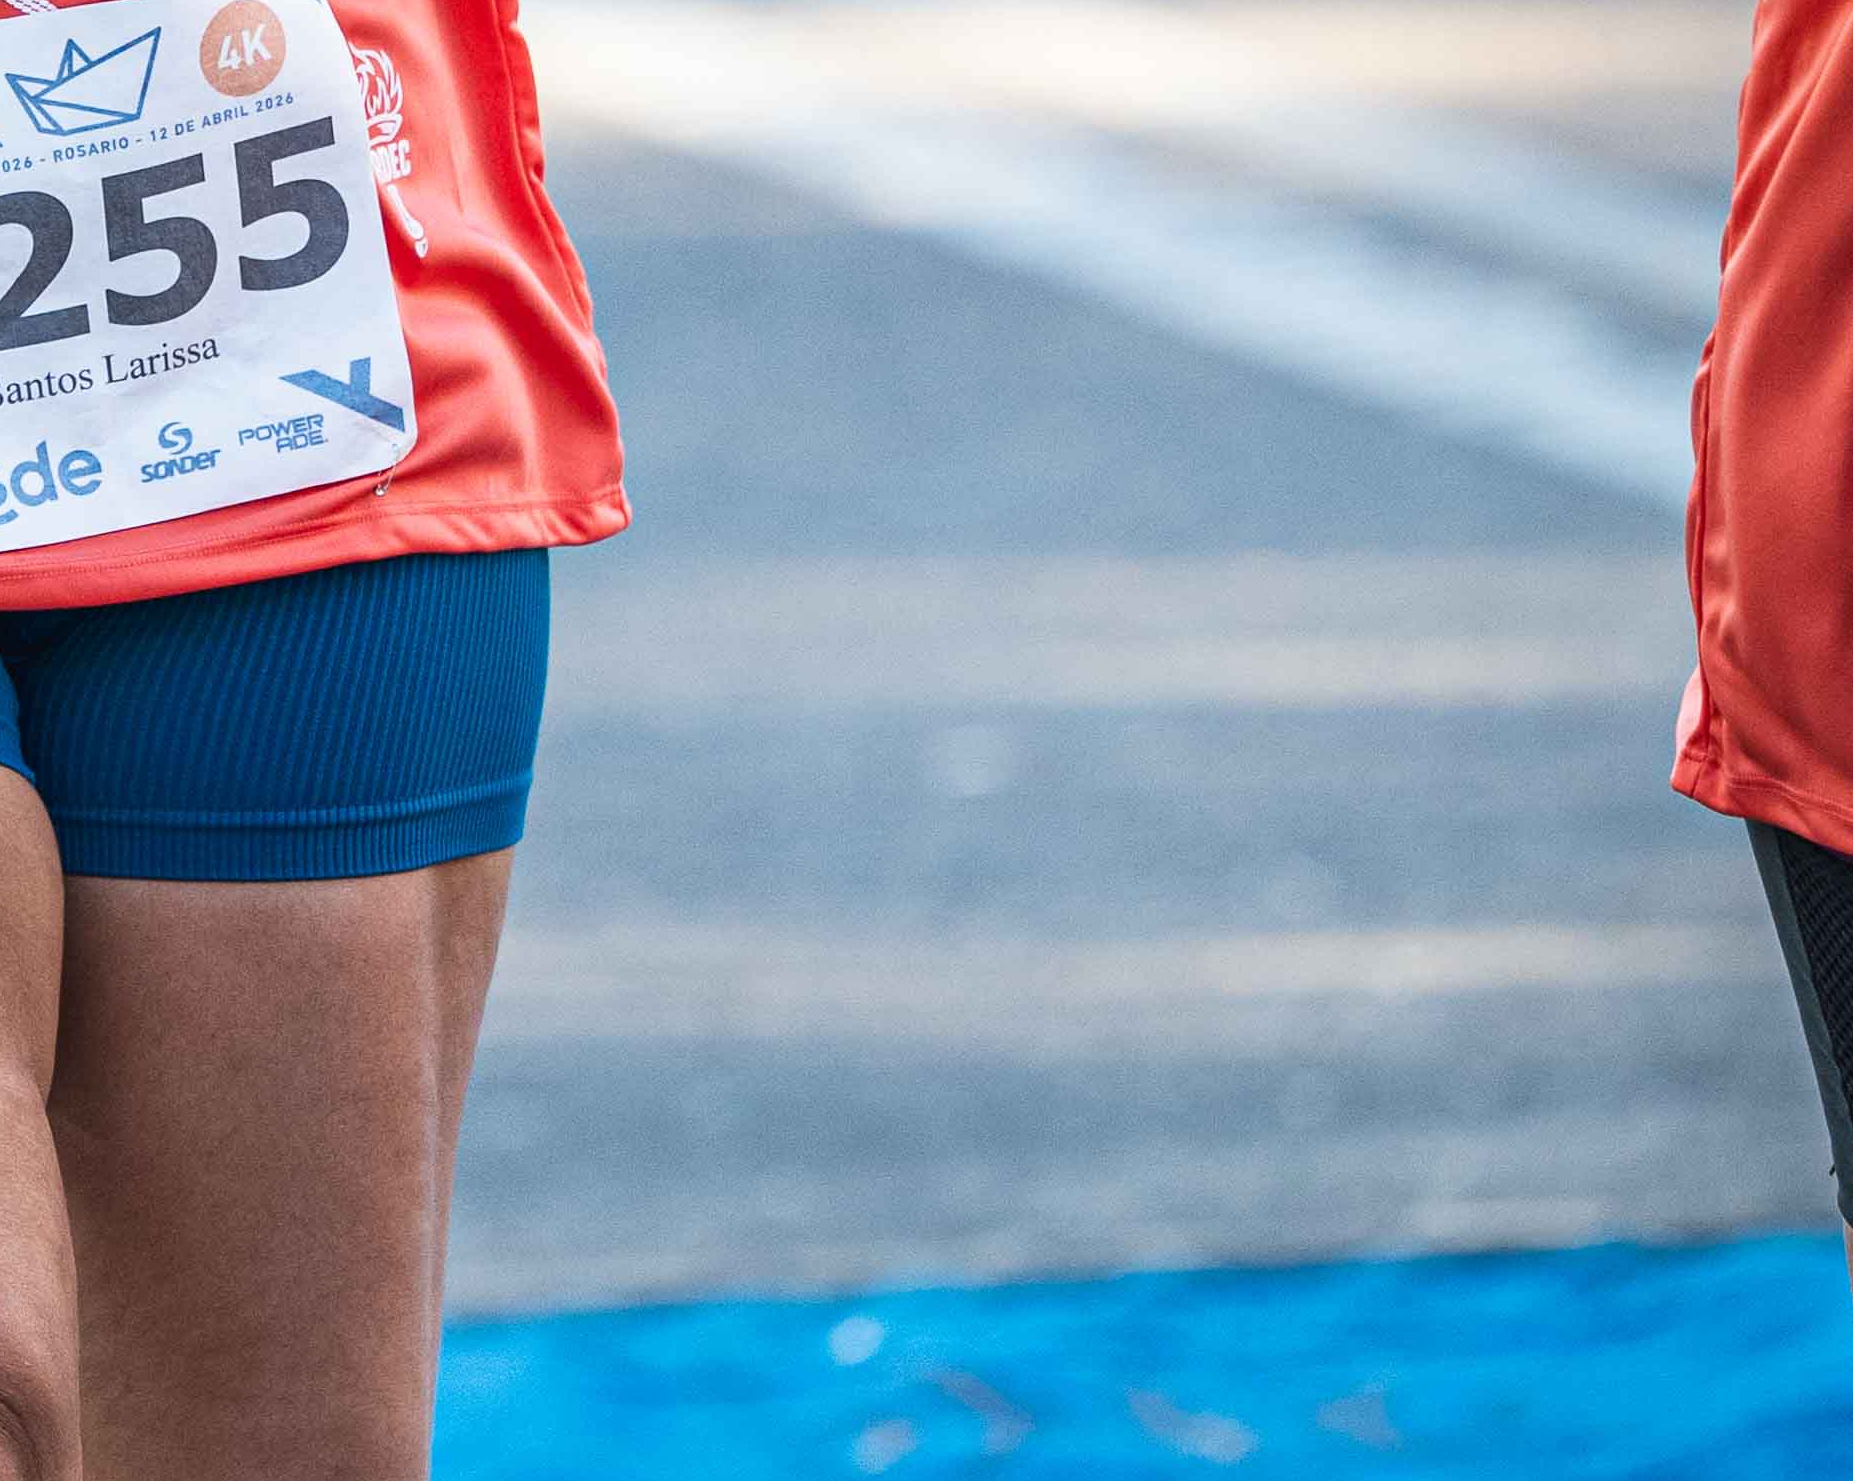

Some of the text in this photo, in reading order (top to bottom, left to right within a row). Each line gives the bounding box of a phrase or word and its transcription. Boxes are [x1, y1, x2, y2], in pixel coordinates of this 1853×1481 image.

[217, 24, 272, 70] 4K
[53, 136, 129, 163] ROSARIO
[150, 127, 168, 142] 12
[174, 119, 195, 136] DE
[201, 104, 249, 129] ABRIL
[255, 92, 294, 113] 2026
[102, 337, 220, 385] Larissa
[238, 413, 324, 446] POWER
